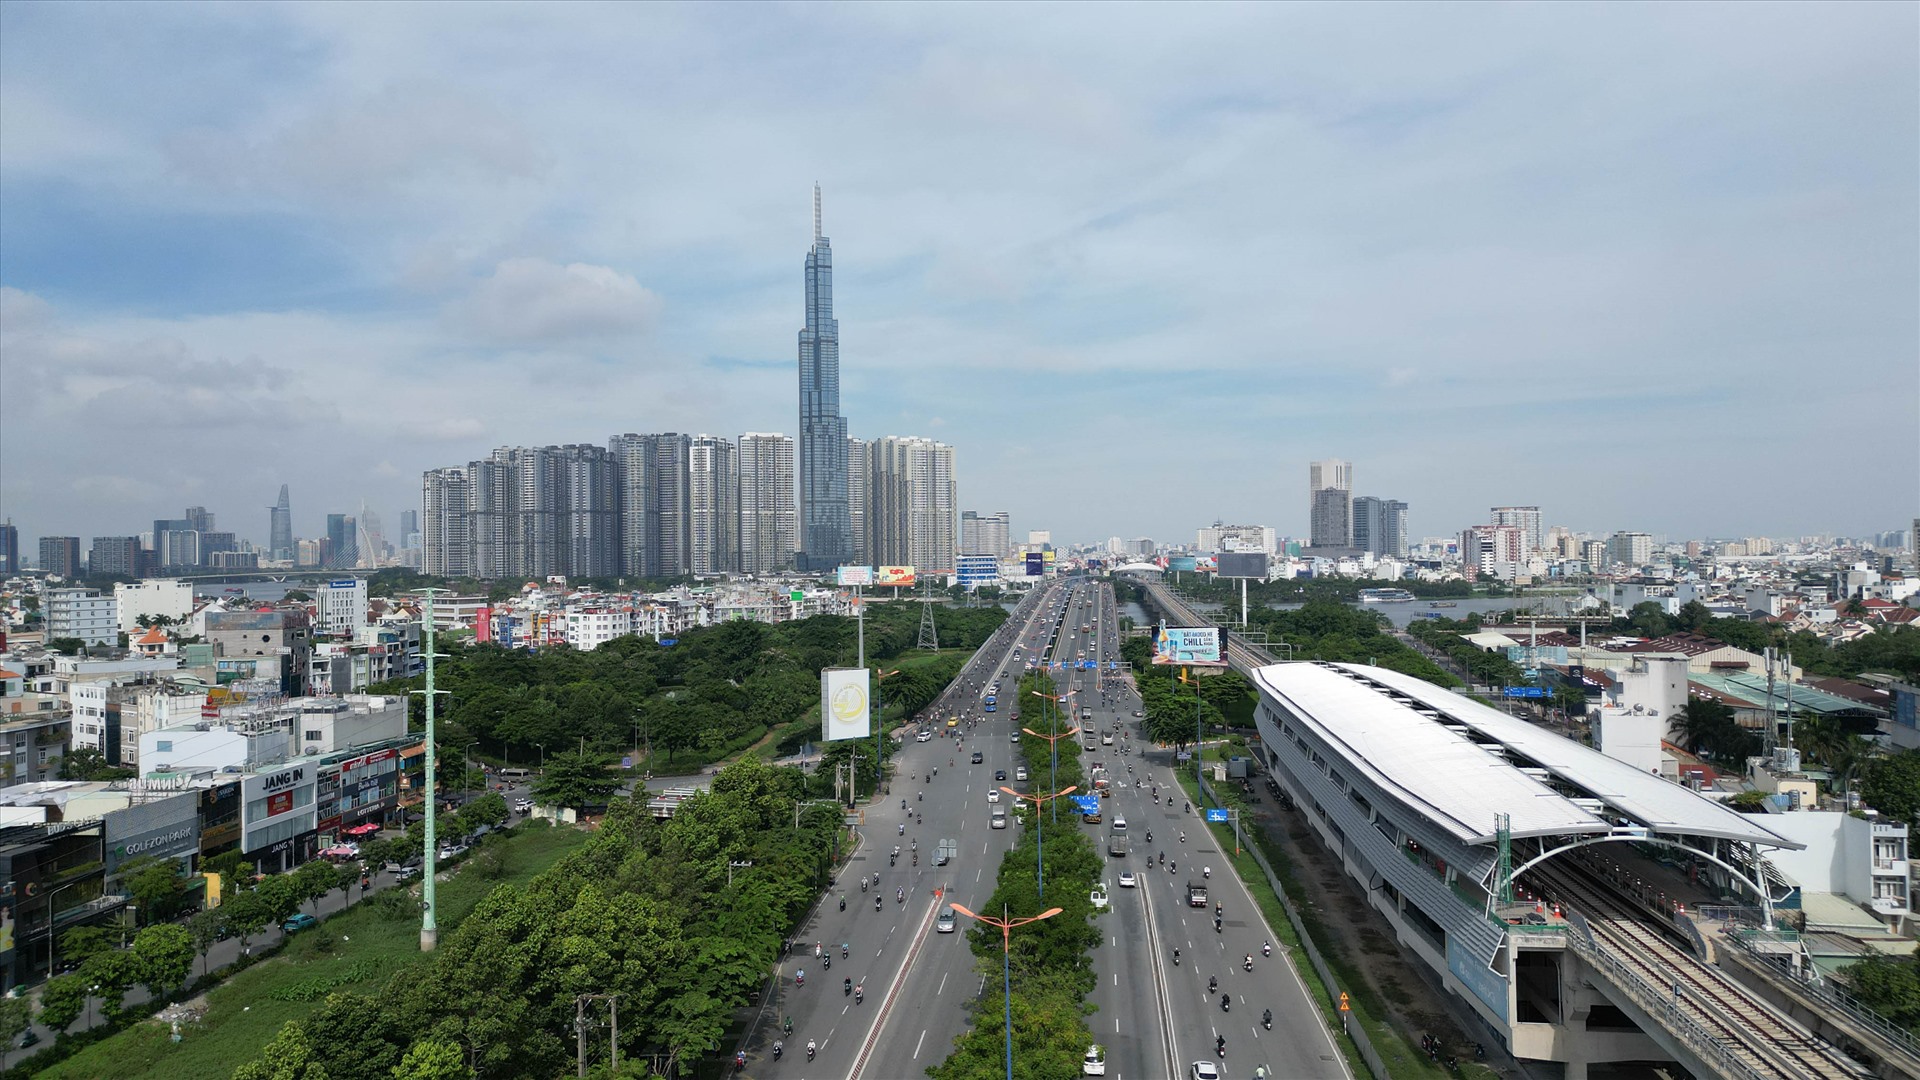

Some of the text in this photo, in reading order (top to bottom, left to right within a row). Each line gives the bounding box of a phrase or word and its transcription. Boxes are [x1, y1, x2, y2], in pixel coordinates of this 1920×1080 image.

[1184, 638, 1203, 646] CHILL
[262, 773, 290, 790] JANG
[293, 768, 303, 781] IN
[126, 836, 168, 855] GOLFZON
[168, 826, 192, 841] PARK
[271, 841, 288, 853] JANG
